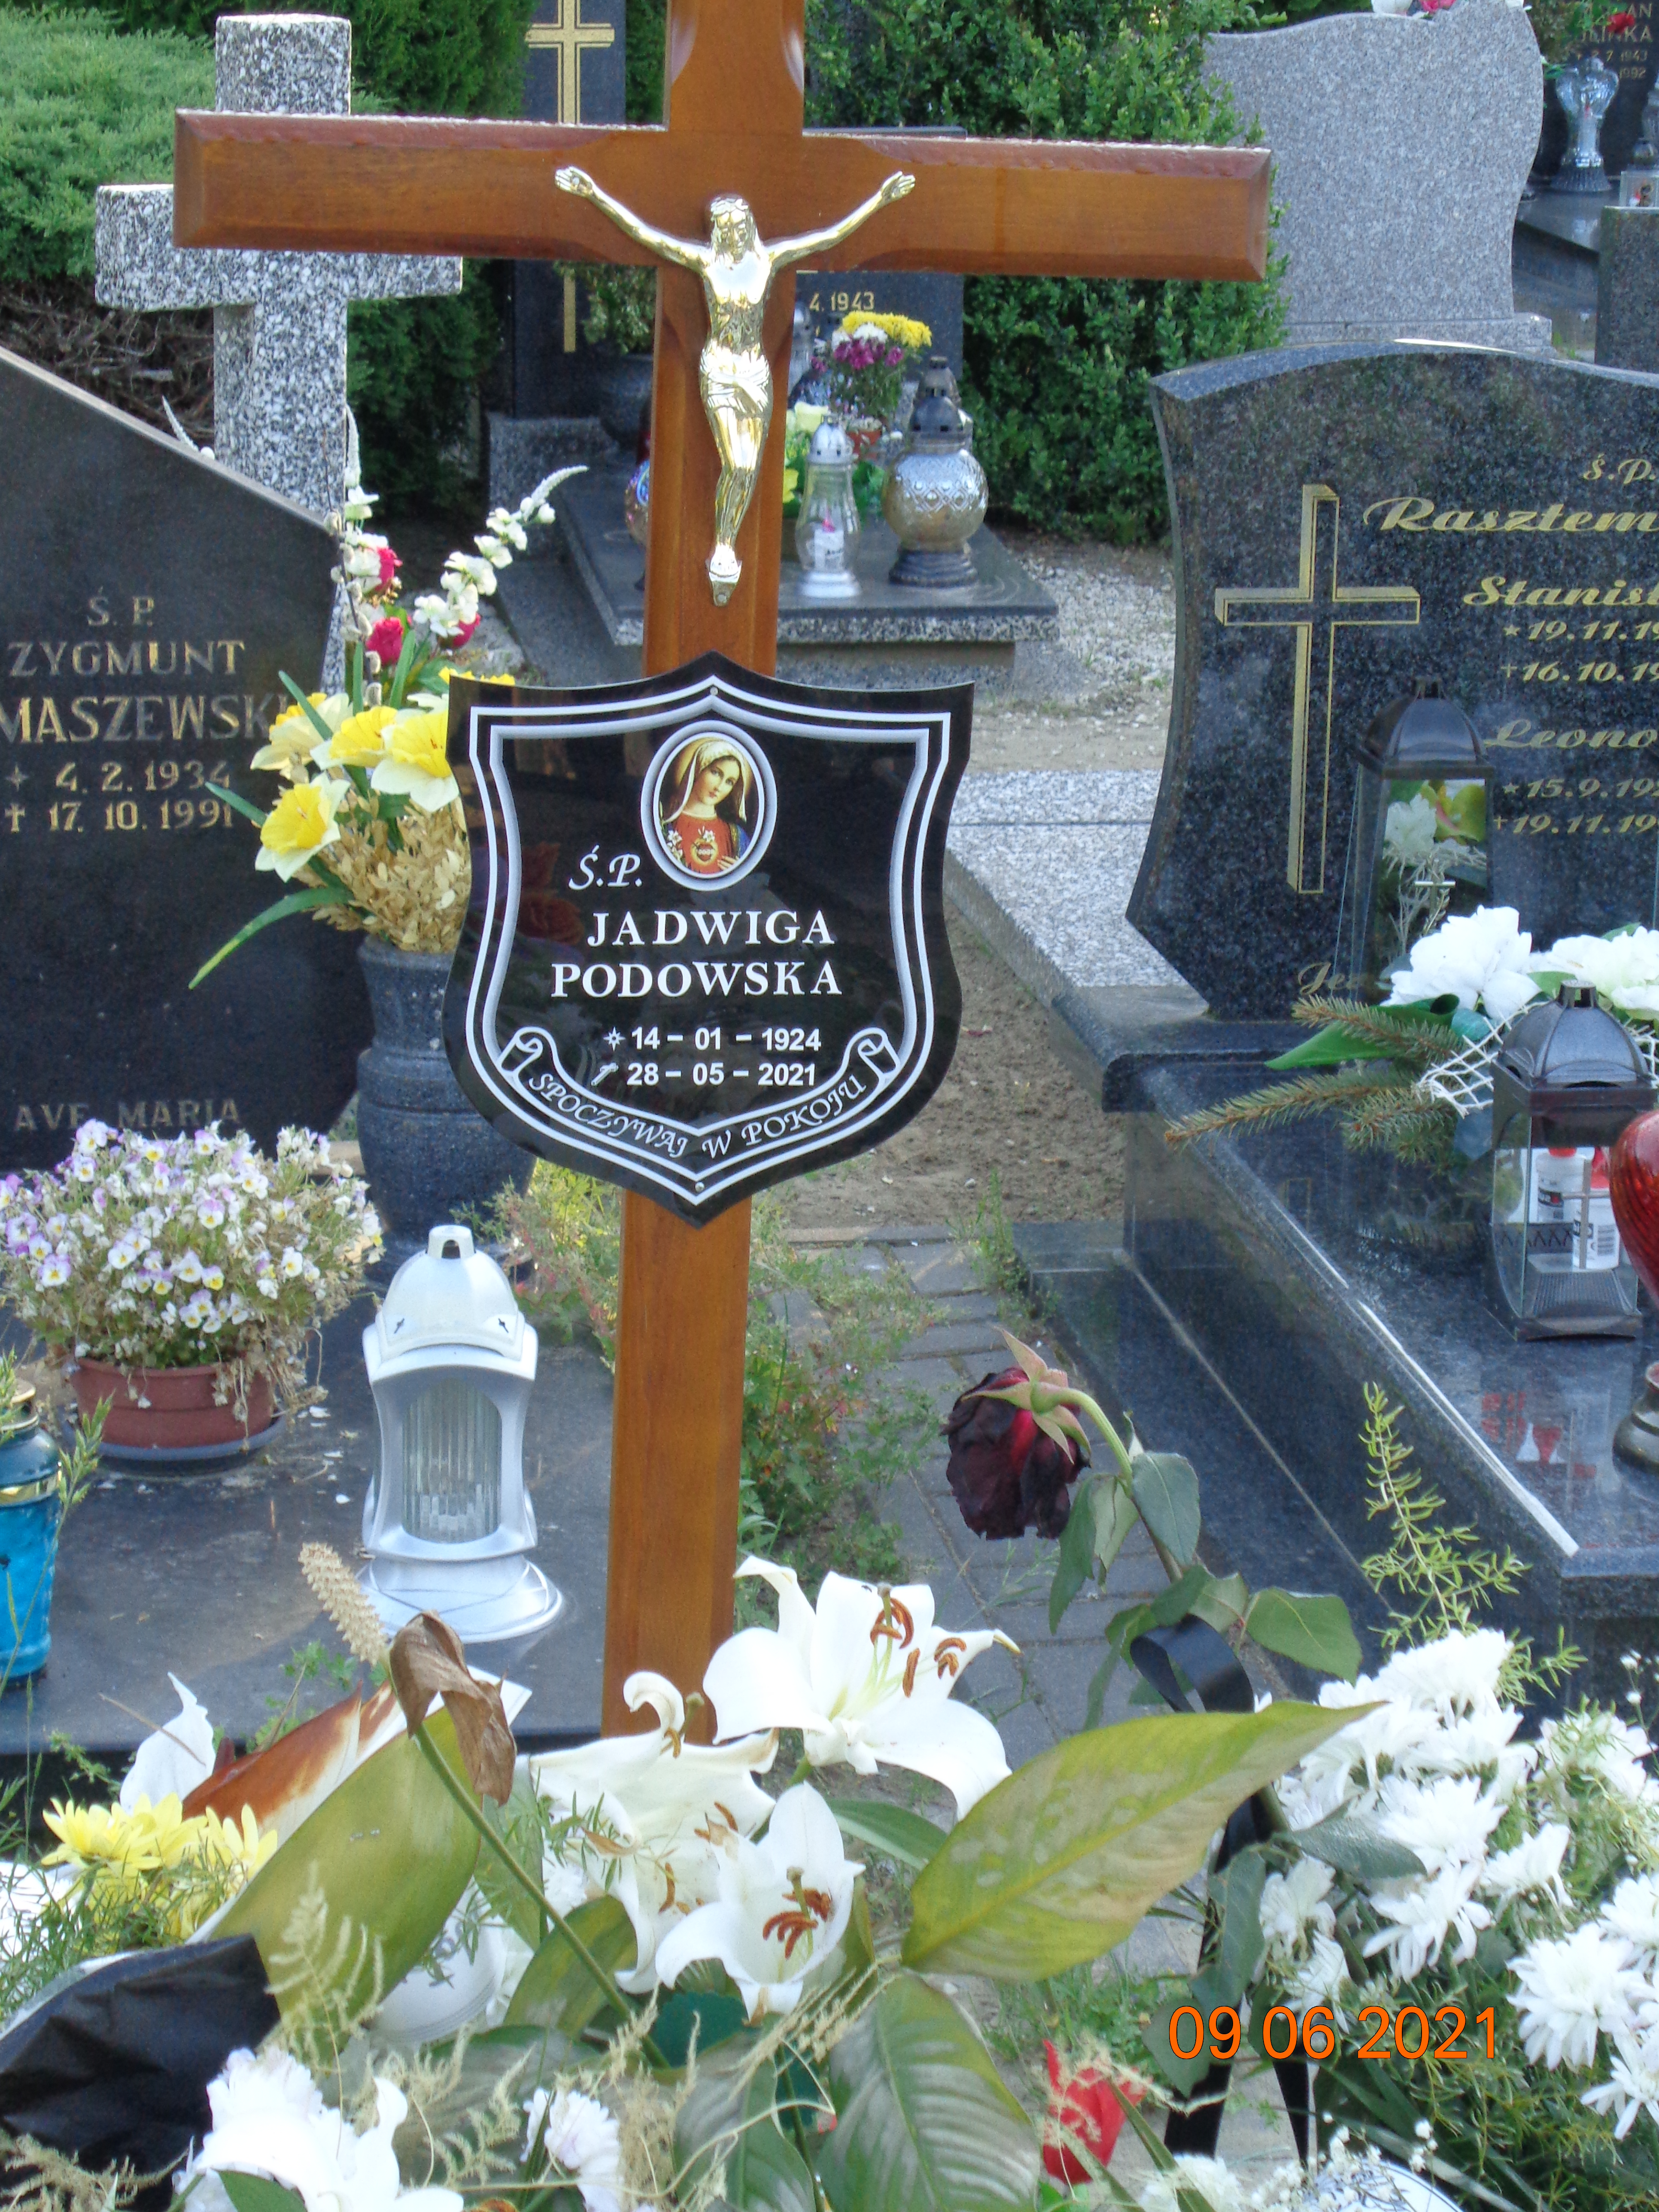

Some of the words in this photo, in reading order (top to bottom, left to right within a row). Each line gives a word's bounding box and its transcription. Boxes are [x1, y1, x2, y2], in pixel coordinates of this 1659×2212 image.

[8, 640, 245, 677] ZYGMUNT
[568, 844, 643, 891] Ś.P.
[587, 909, 835, 947] JADWIGA
[551, 960, 842, 999] PODOWSKA
[15, 1104, 88, 1131] AVE
[117, 1098, 240, 1128] MARIA
[529, 1073, 689, 1158] SPOCZYWAJ
[702, 1130, 732, 1159] W
[741, 1075, 867, 1146] POKOJU
